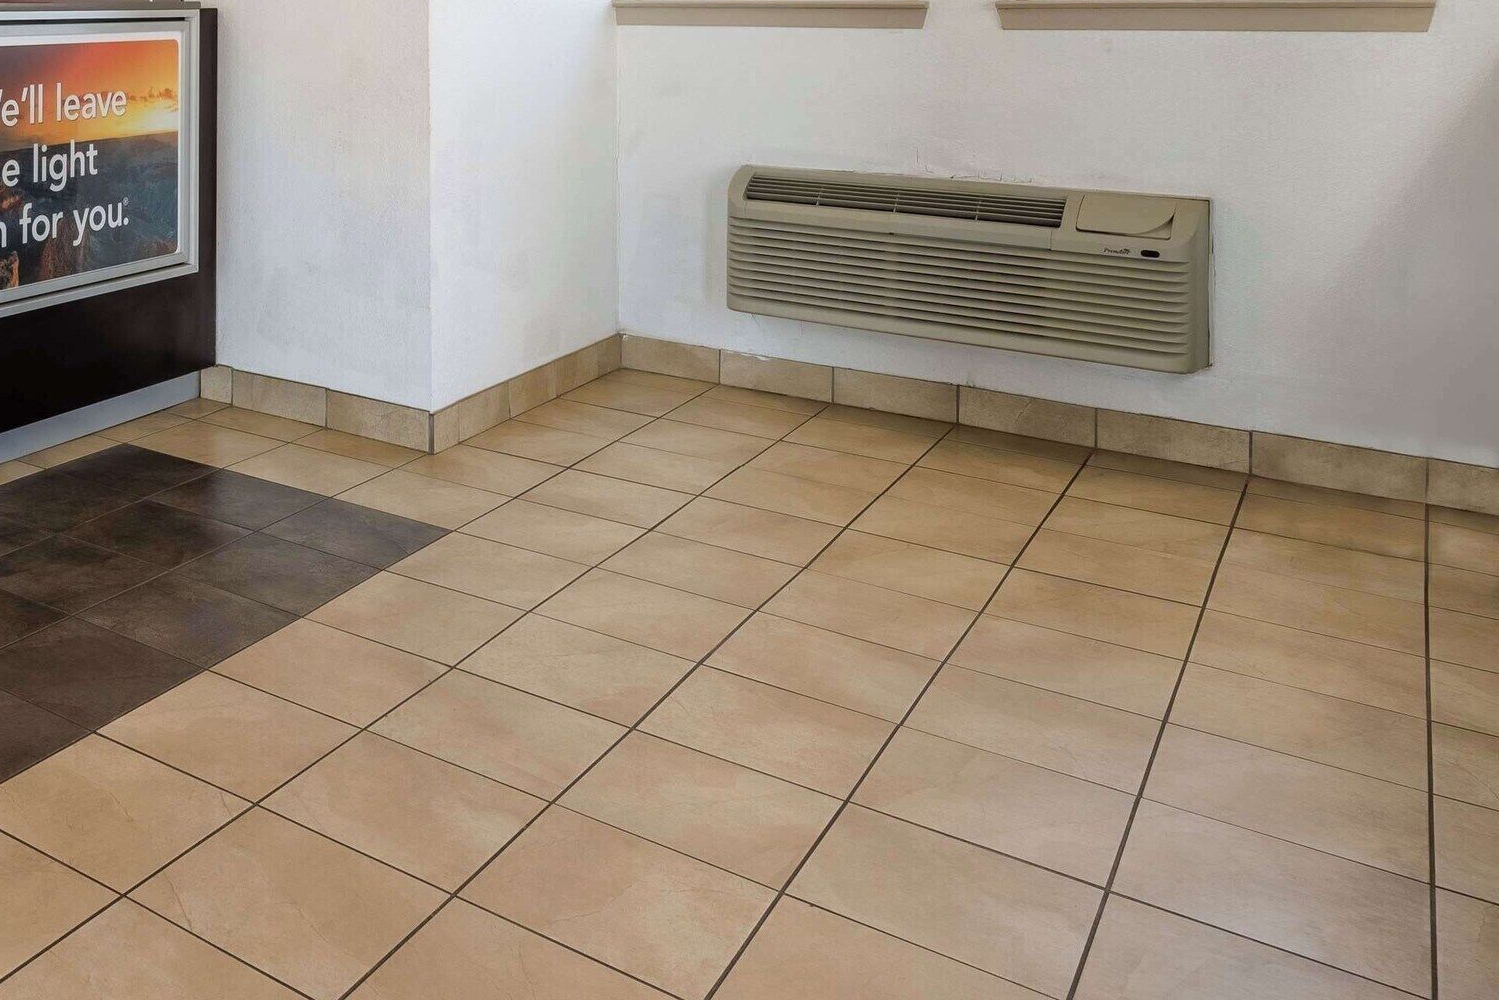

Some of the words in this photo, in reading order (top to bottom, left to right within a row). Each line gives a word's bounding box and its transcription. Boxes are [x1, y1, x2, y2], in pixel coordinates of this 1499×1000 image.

[56, 82, 127, 122] leave
[33, 139, 98, 192] light
[19, 202, 63, 244] for
